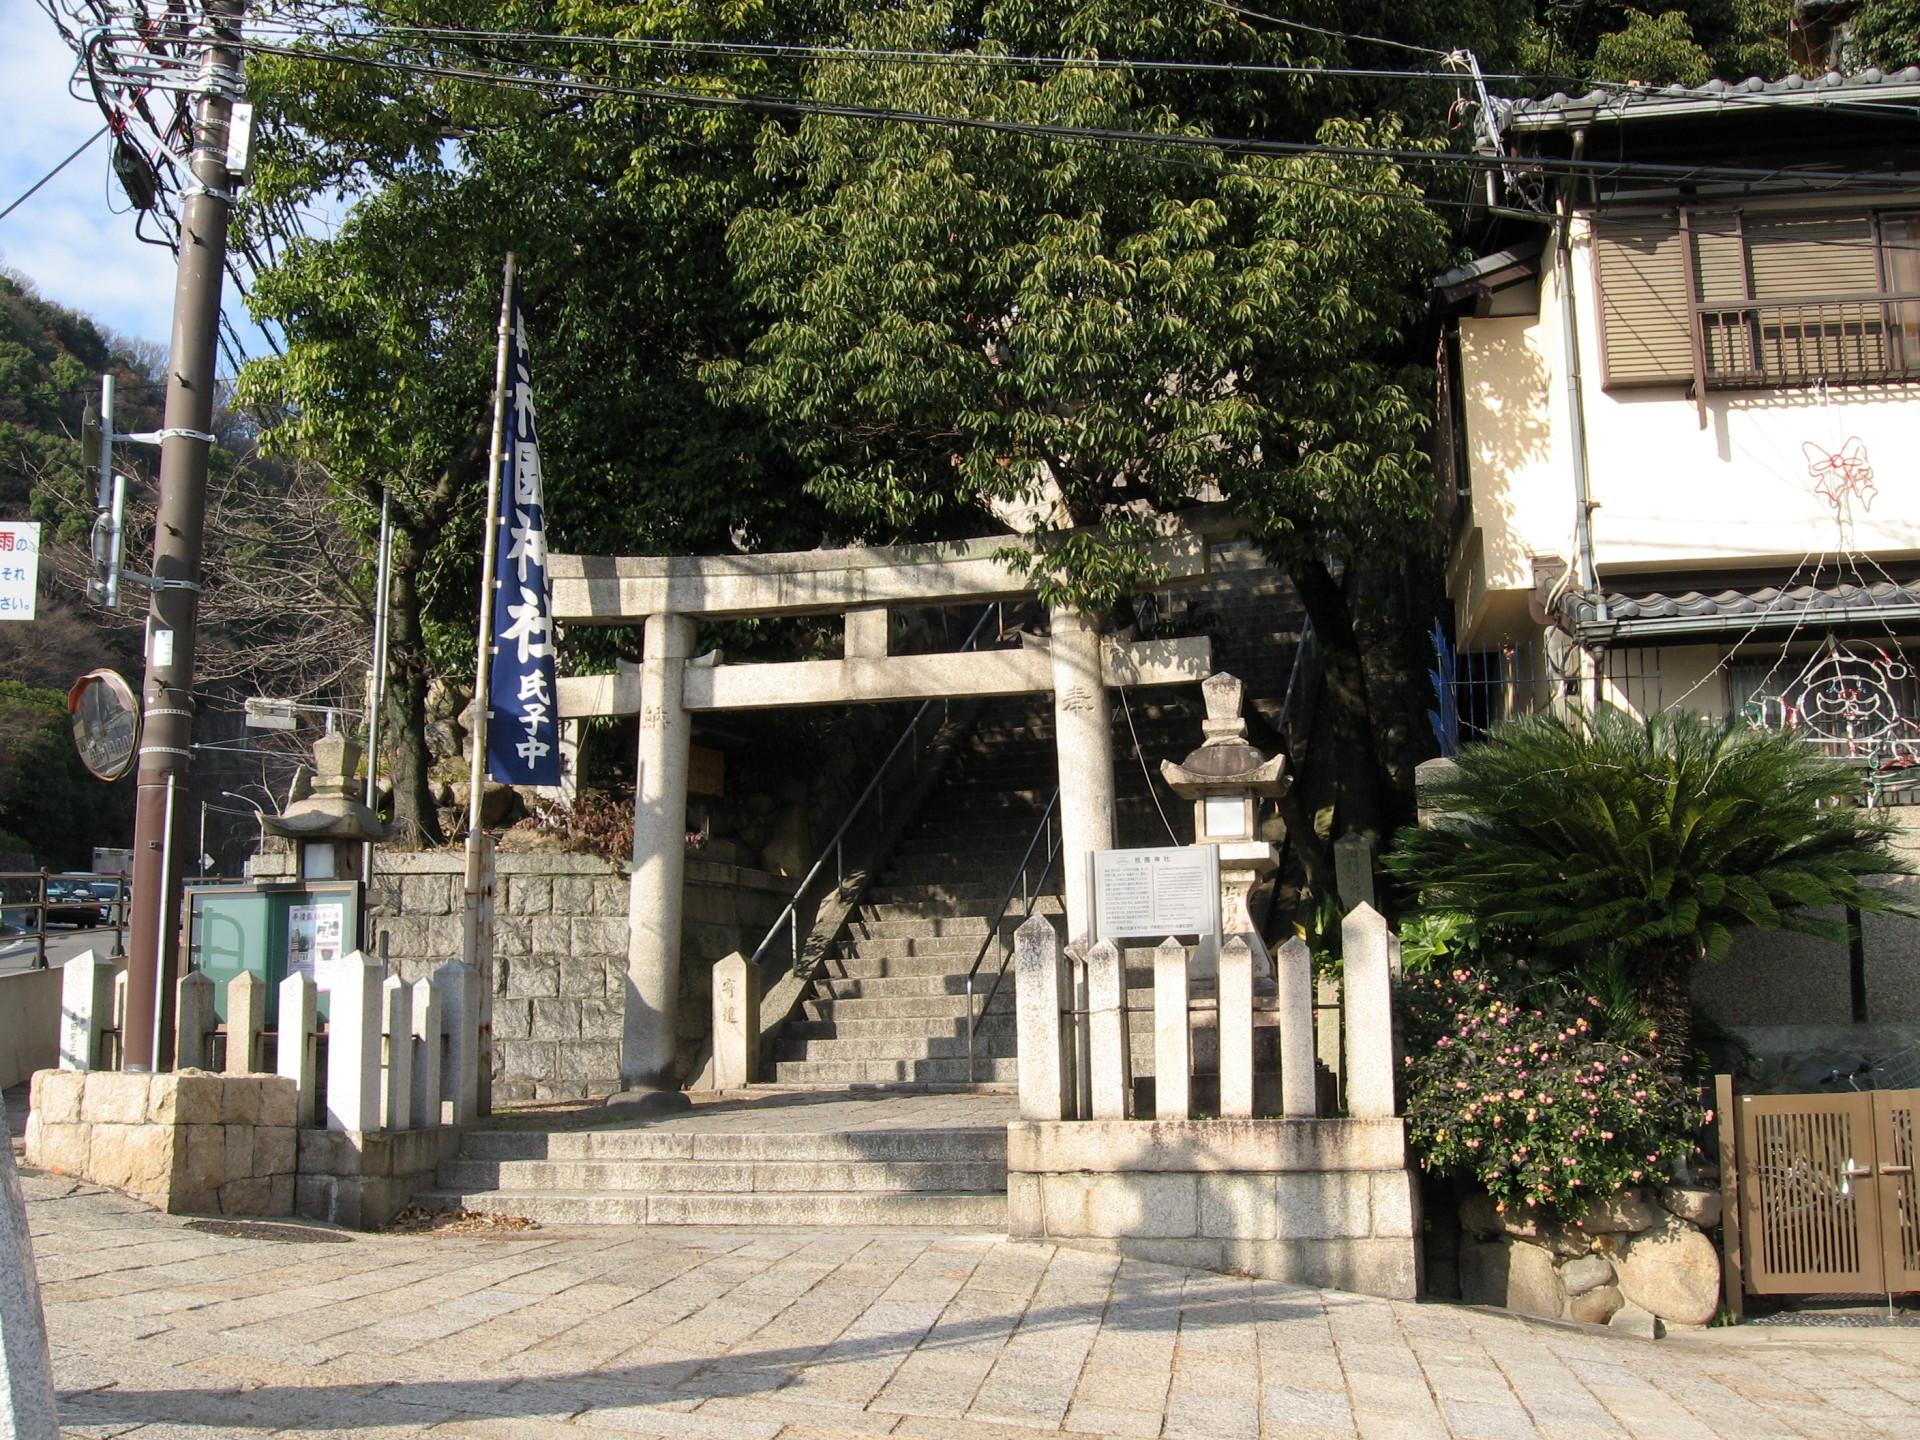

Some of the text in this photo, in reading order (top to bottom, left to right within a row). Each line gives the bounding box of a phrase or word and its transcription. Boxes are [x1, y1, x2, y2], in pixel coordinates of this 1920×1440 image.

[1, 567, 25, 582] それ
[1062, 685, 1095, 717] 奉
[516, 669, 551, 770] 氏子中
